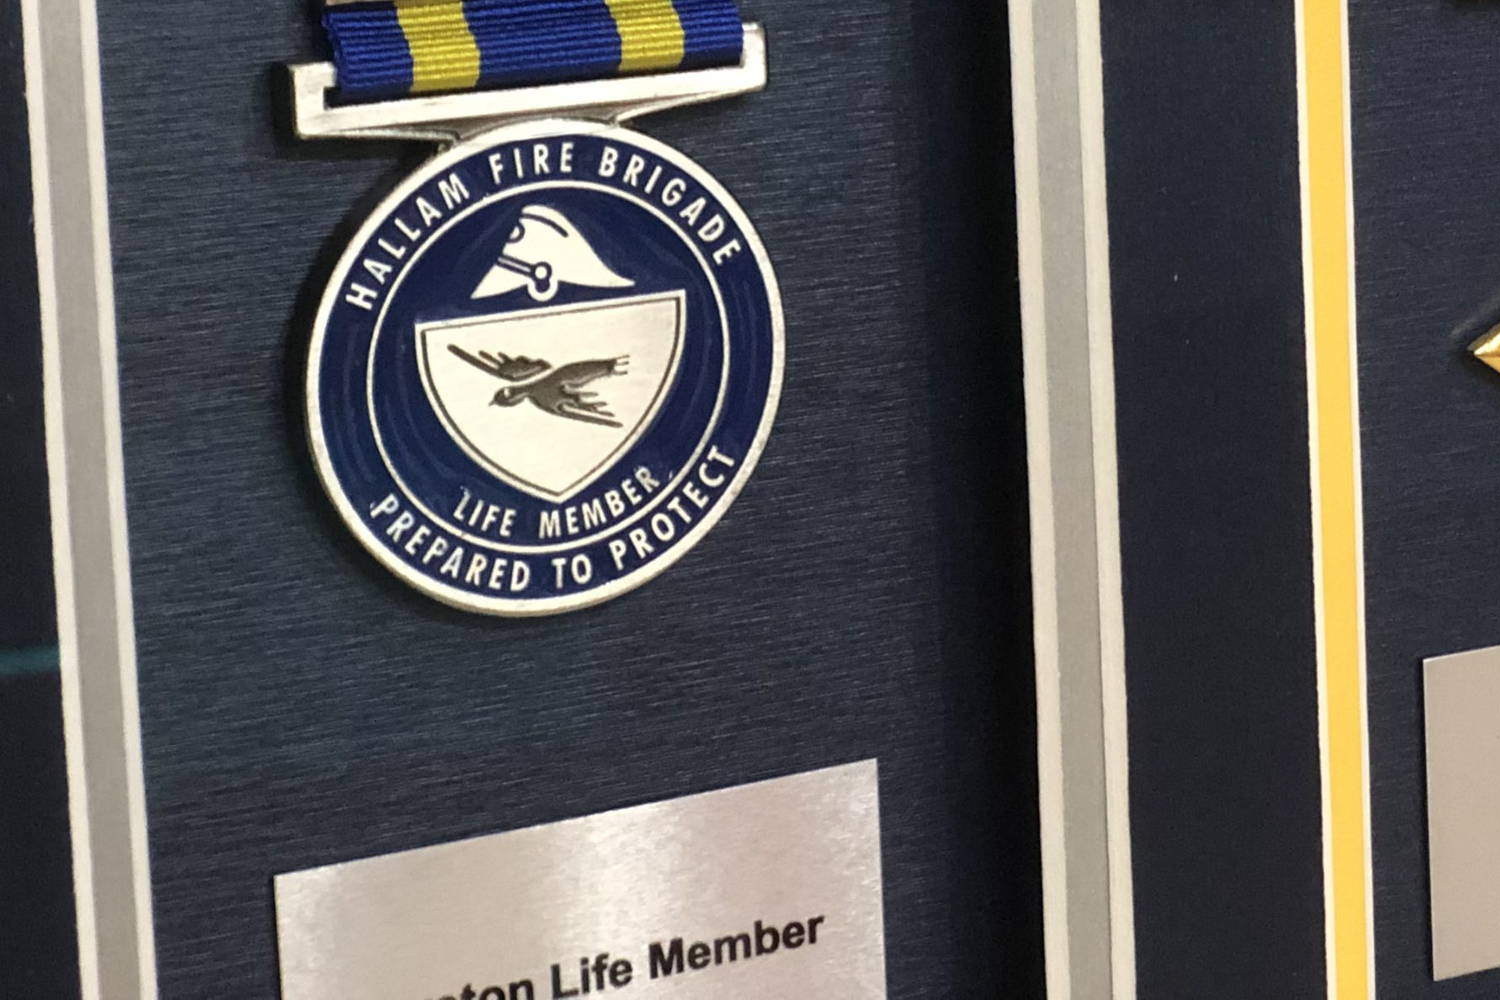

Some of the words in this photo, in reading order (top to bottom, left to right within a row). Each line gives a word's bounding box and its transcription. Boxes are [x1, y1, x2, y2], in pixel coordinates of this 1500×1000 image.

[345, 171, 470, 311] HALLAM
[489, 142, 575, 185] FIRE
[598, 145, 741, 267] BRIGADE
[371, 493, 531, 592] PREPARED
[552, 552, 593, 590] TO
[609, 445, 736, 570] PROTECT
[453, 489, 516, 538] LIFE
[538, 465, 661, 539] MEMBER
[551, 953, 633, 1000] Life
[648, 914, 826, 980] Member
